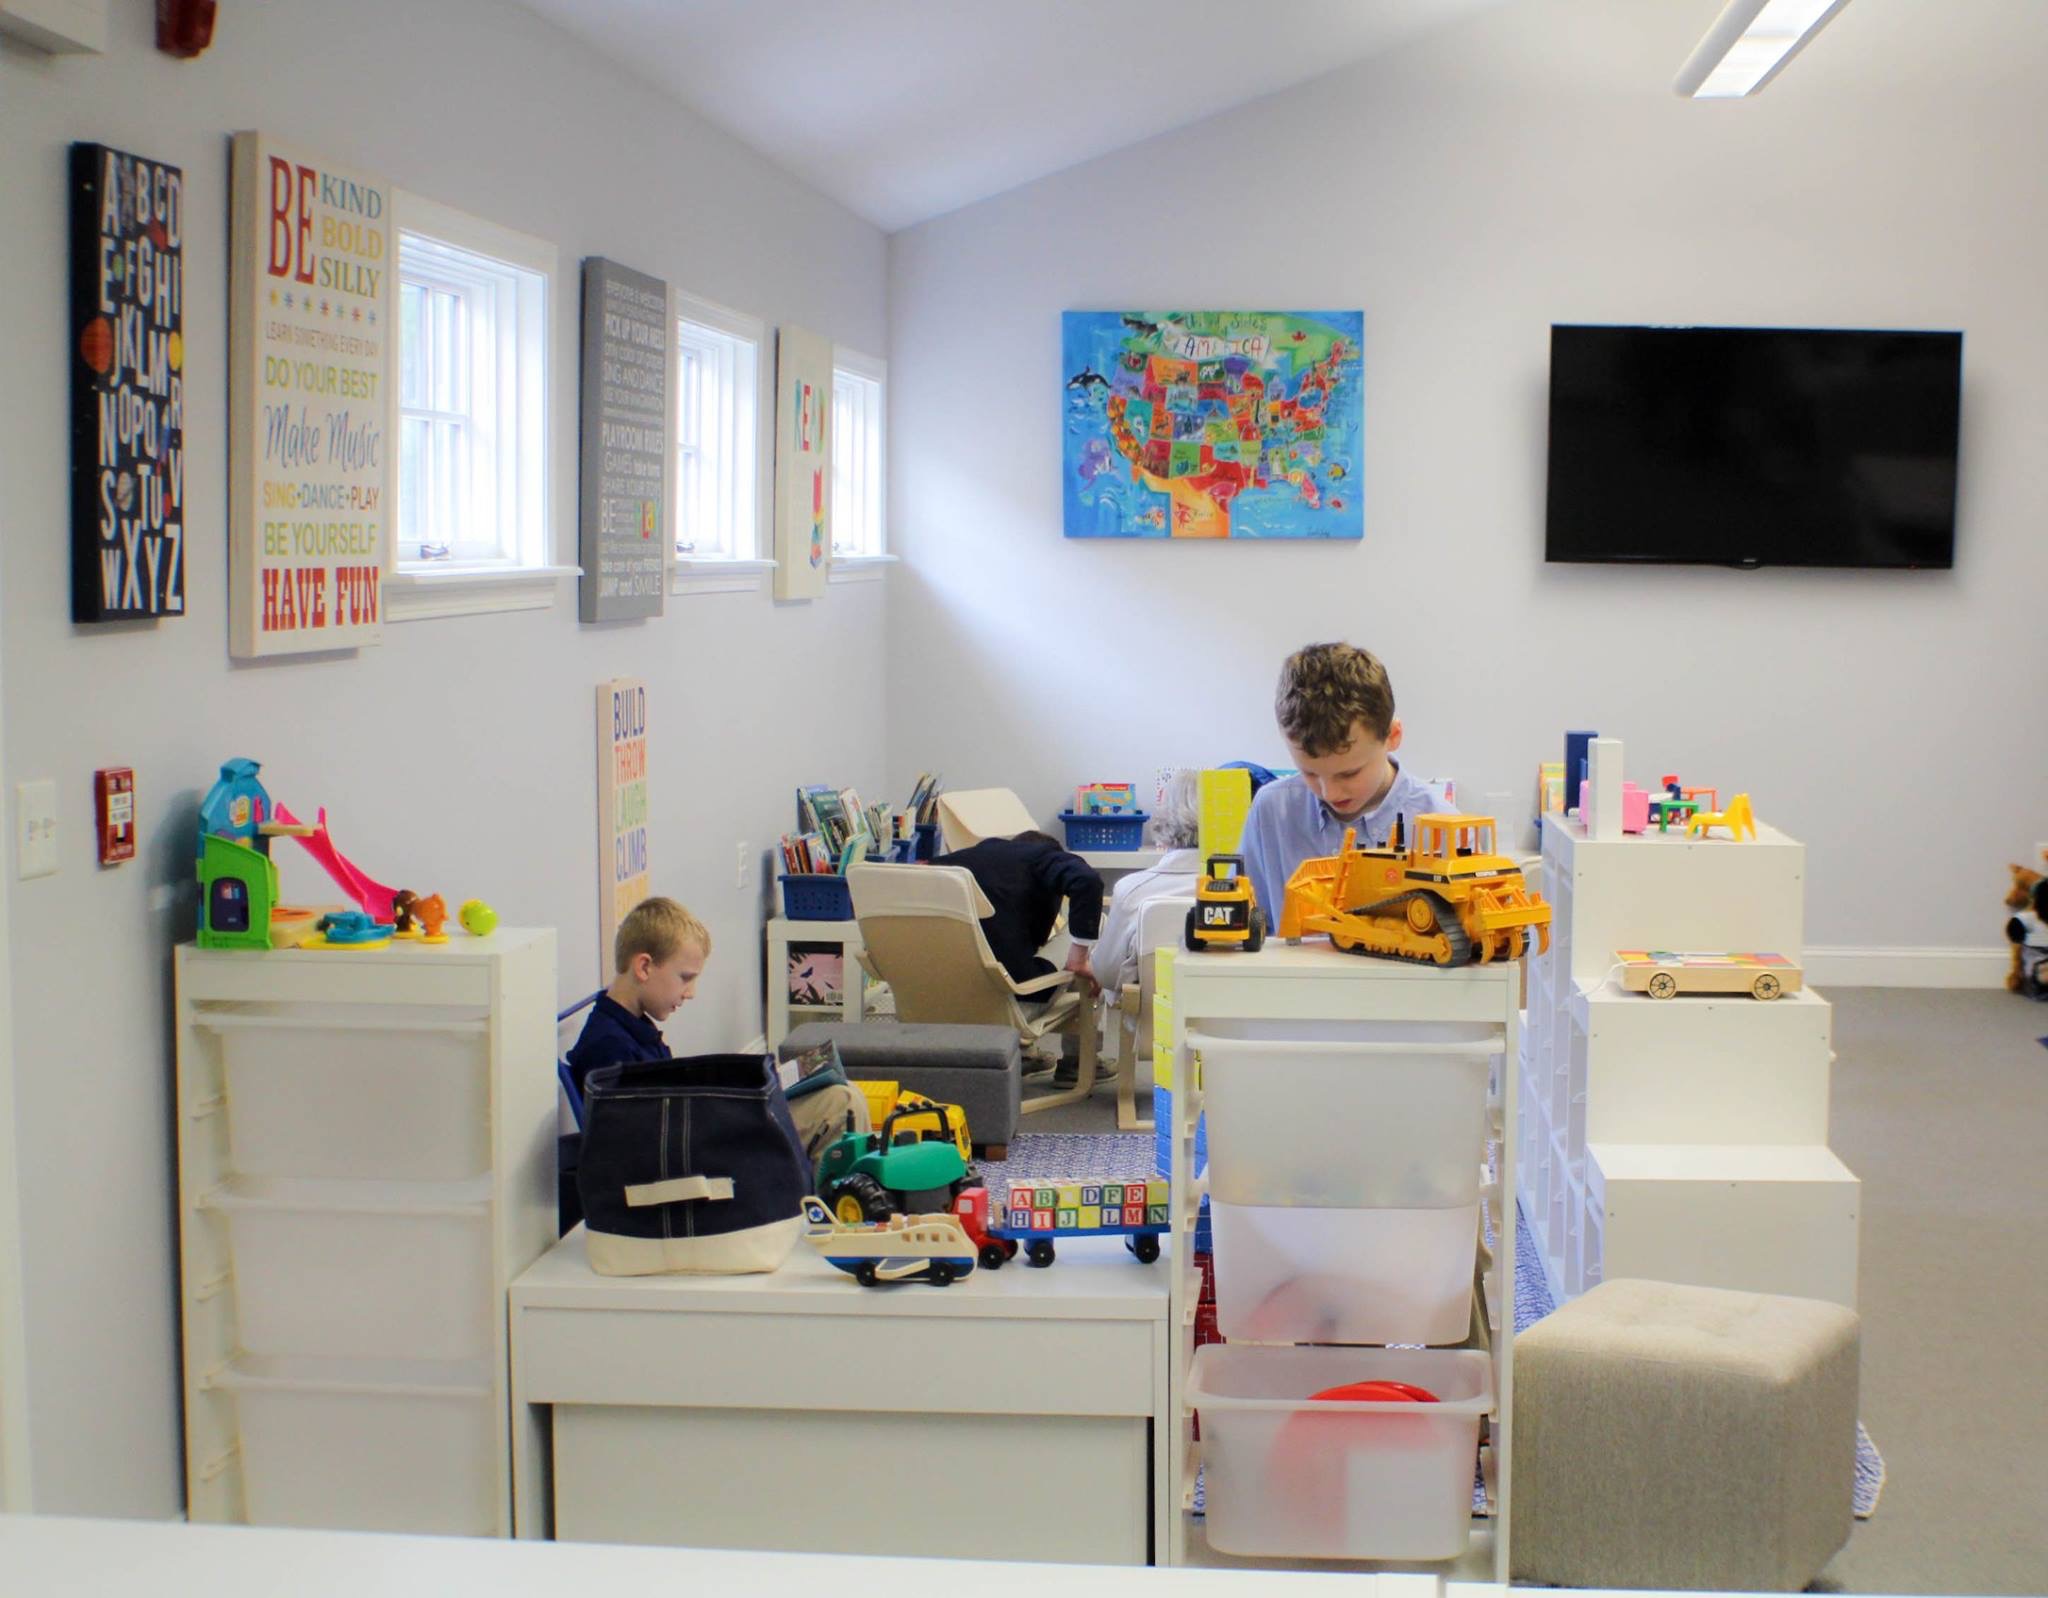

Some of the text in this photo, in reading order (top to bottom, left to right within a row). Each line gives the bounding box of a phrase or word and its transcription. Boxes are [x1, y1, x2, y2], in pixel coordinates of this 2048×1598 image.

[267, 154, 316, 285] BE
[321, 172, 383, 220] KIND
[321, 214, 384, 261] BOLD
[319, 255, 382, 300] SILLY
[265, 320, 293, 345] LEARN
[265, 355, 378, 400] DO YOUR BEST
[264, 402, 380, 473] Make Music
[601, 421, 643, 451] PLAYROOM
[264, 521, 377, 556] BE YOURSELF
[601, 498, 616, 534] BE
[262, 565, 379, 631] HAVE FUN
[614, 686, 645, 742] BUILD
[614, 738, 646, 785] THROW
[616, 827, 647, 882] CLIMB
[1203, 907, 1235, 925] CAT
